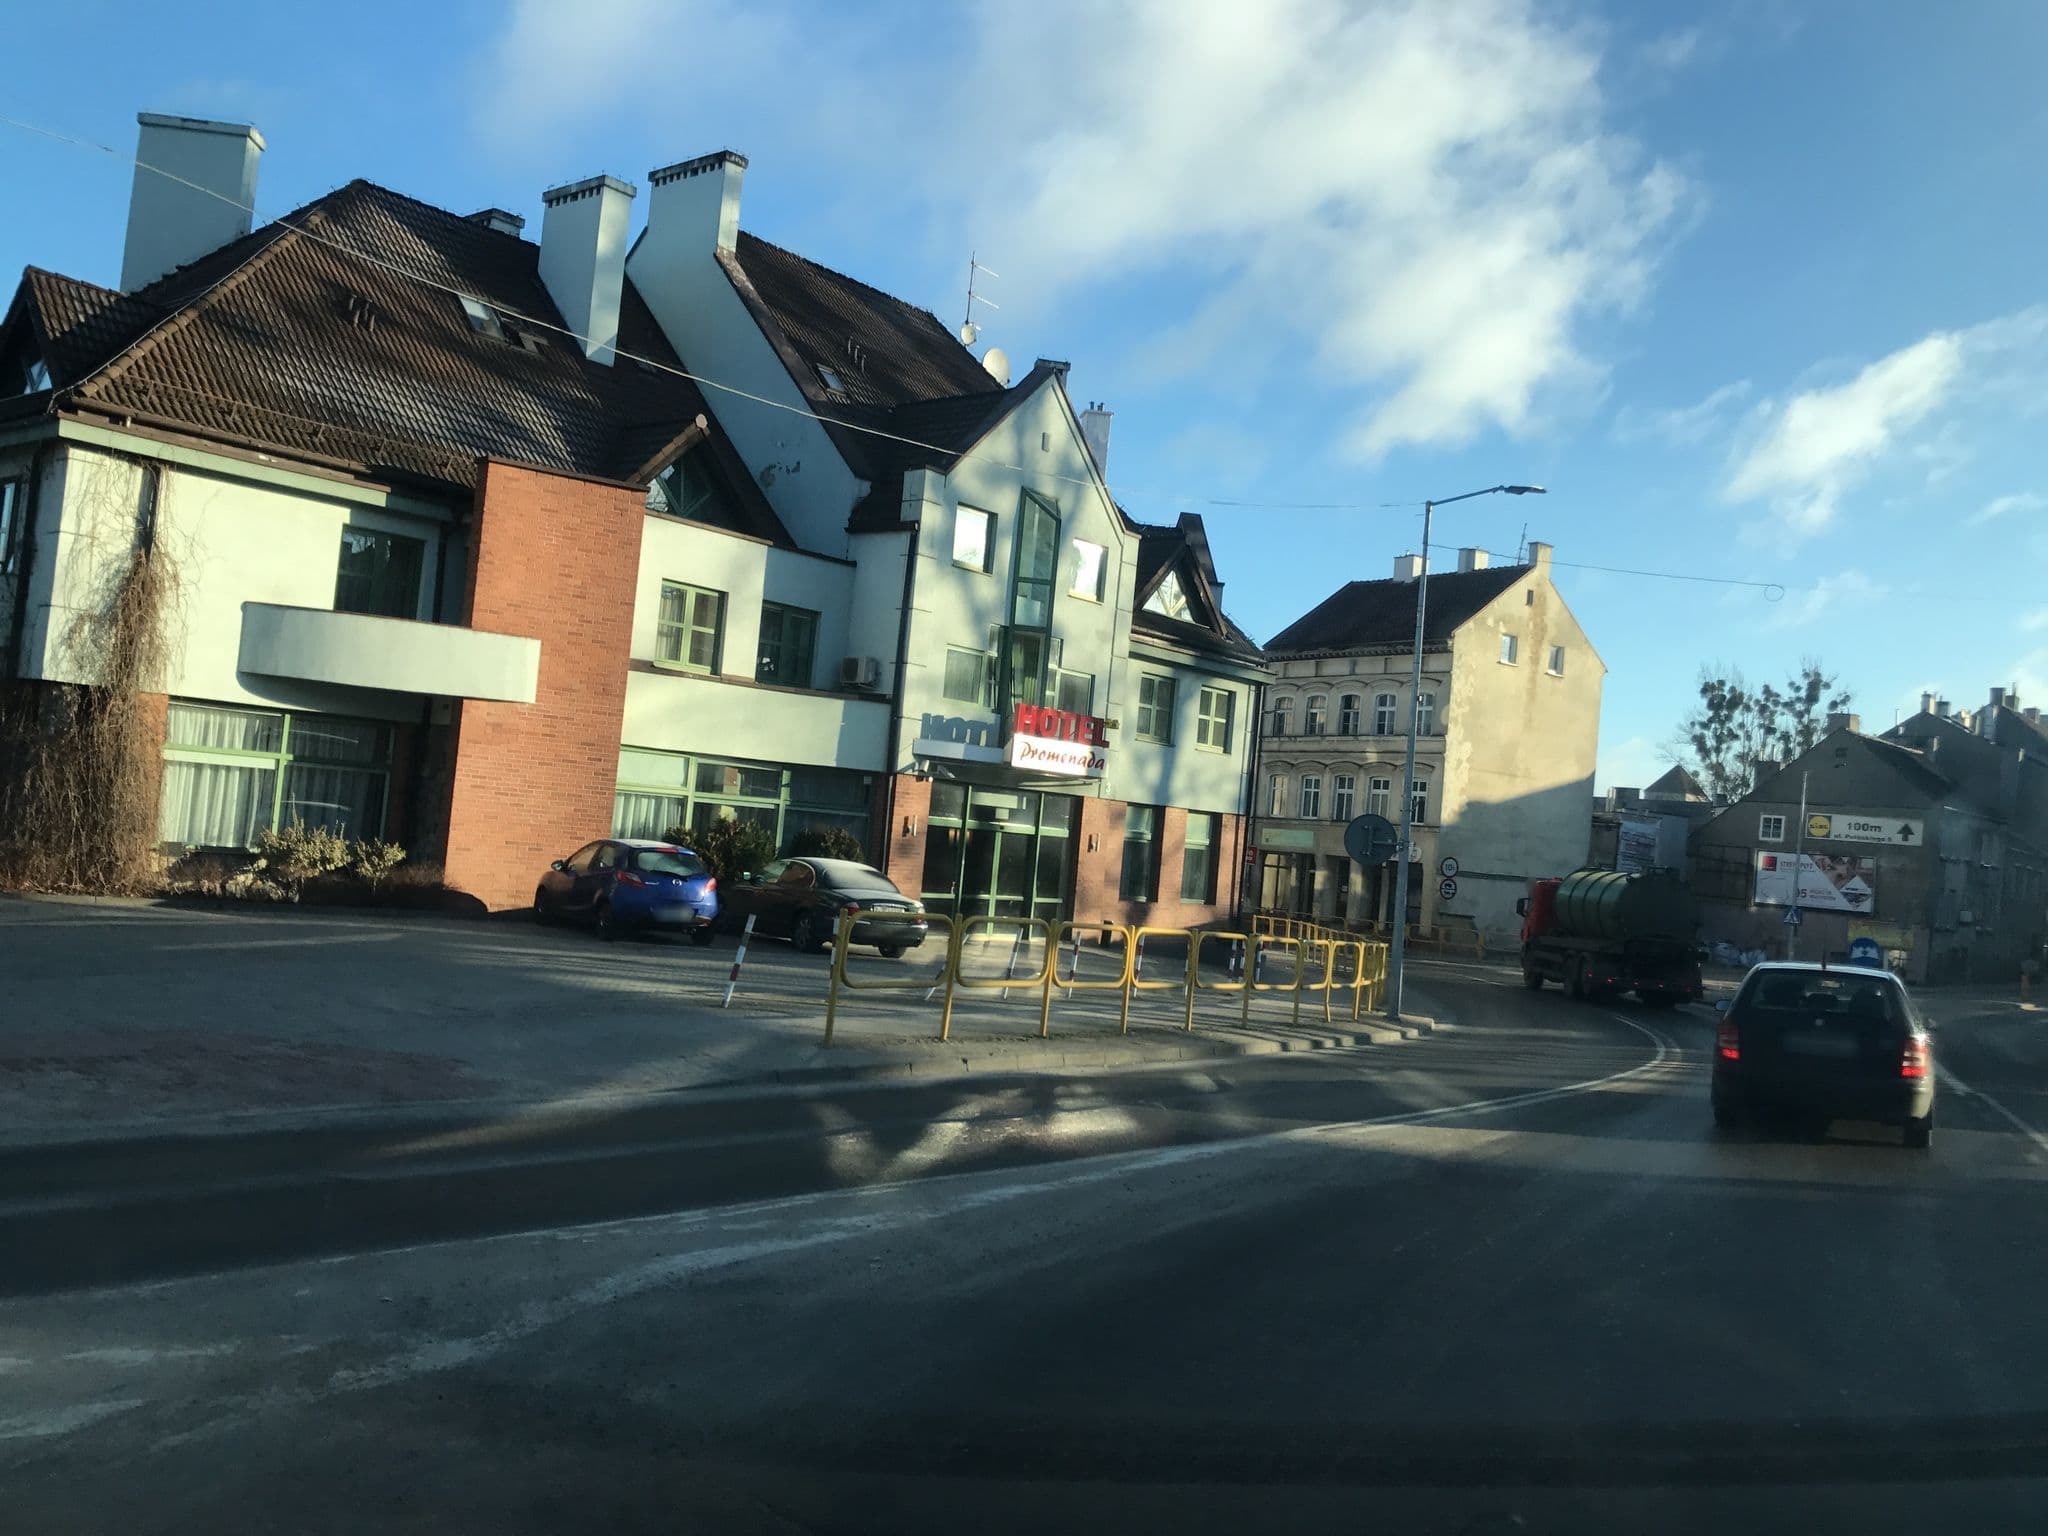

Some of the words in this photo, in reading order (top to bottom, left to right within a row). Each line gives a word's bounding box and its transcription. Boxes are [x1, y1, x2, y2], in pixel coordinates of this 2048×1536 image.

[1016, 703, 1109, 748] HOTEL
[1020, 742, 1105, 770] Promenada
[1847, 822, 1882, 833] 100m
